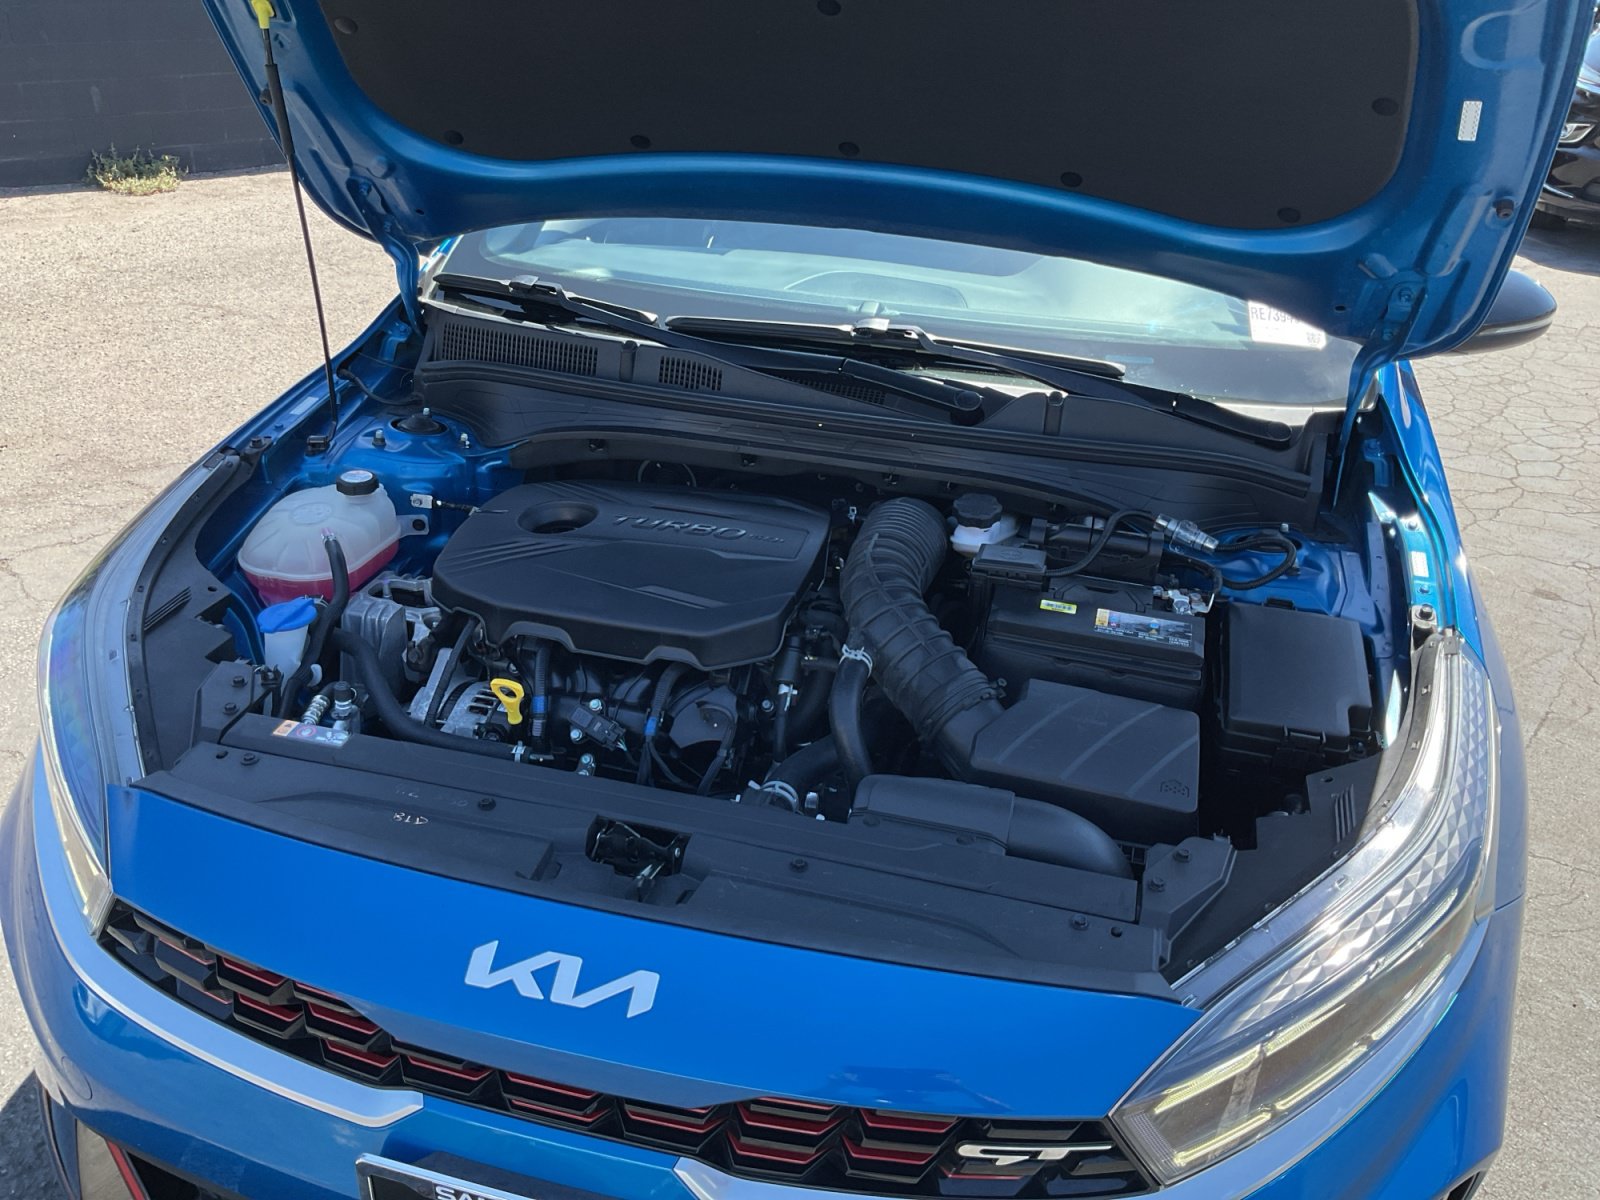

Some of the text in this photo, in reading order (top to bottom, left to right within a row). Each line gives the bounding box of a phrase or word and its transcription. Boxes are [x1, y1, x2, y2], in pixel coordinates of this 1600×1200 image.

[612, 513, 747, 541] TURBO
[464, 940, 660, 1018] KIA
[957, 1143, 1113, 1166] GT
